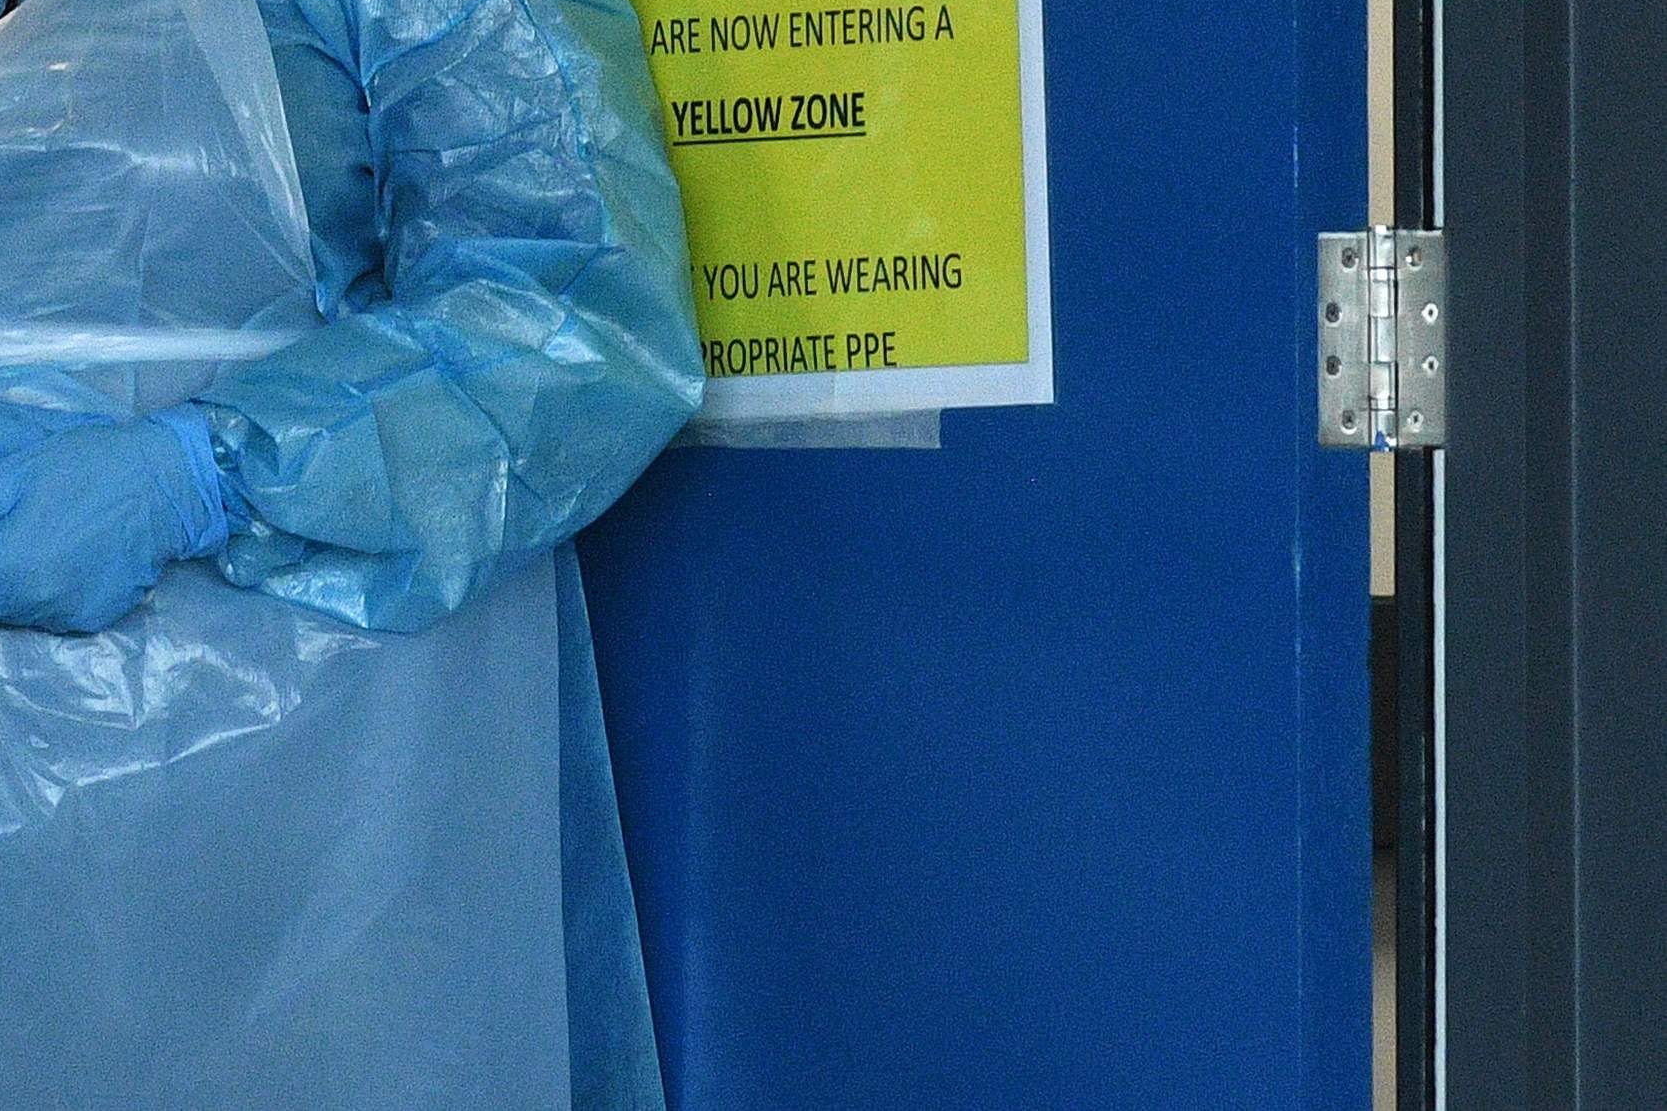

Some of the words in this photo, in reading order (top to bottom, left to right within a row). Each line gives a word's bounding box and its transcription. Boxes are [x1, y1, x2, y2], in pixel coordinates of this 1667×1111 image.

[650, 17, 702, 56] ARE
[710, 12, 780, 52] NOW
[789, 5, 927, 48] ENTERING
[934, 3, 955, 41] A
[671, 96, 783, 137] YELLOW
[790, 91, 866, 131] ZONE
[703, 263, 759, 301] YOU
[767, 259, 818, 298] ARE
[825, 253, 964, 295] WEARING
[845, 331, 898, 371] PPE
